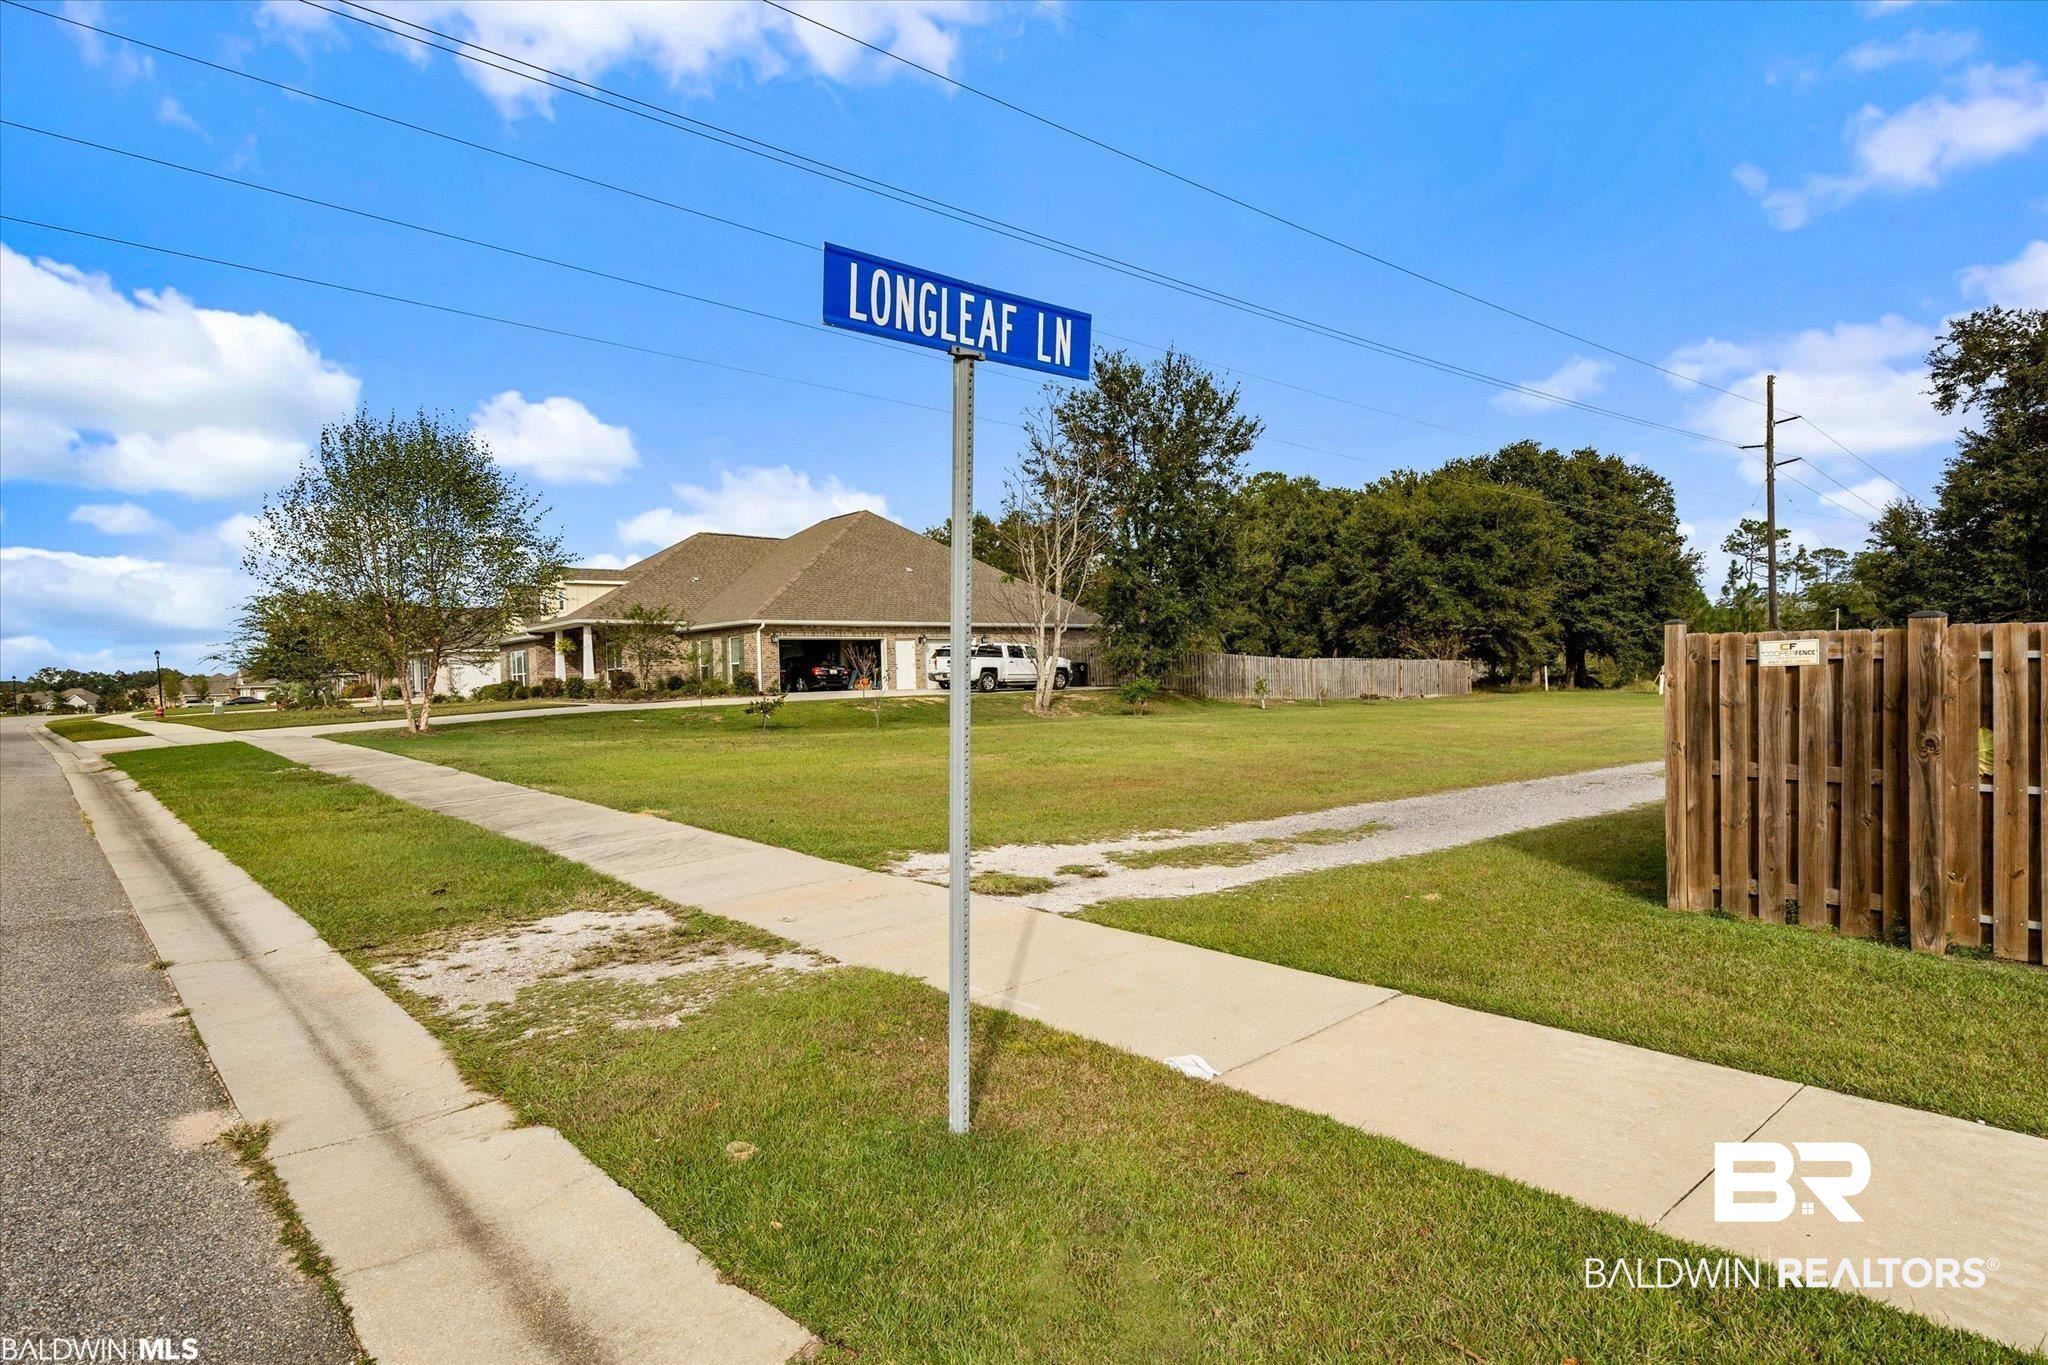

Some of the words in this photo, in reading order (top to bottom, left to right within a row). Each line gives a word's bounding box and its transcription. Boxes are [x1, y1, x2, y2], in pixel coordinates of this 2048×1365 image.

[849, 262, 1017, 354] LONGLEAF
[1037, 312, 1072, 367] LN
[1780, 642, 1797, 650] CF
